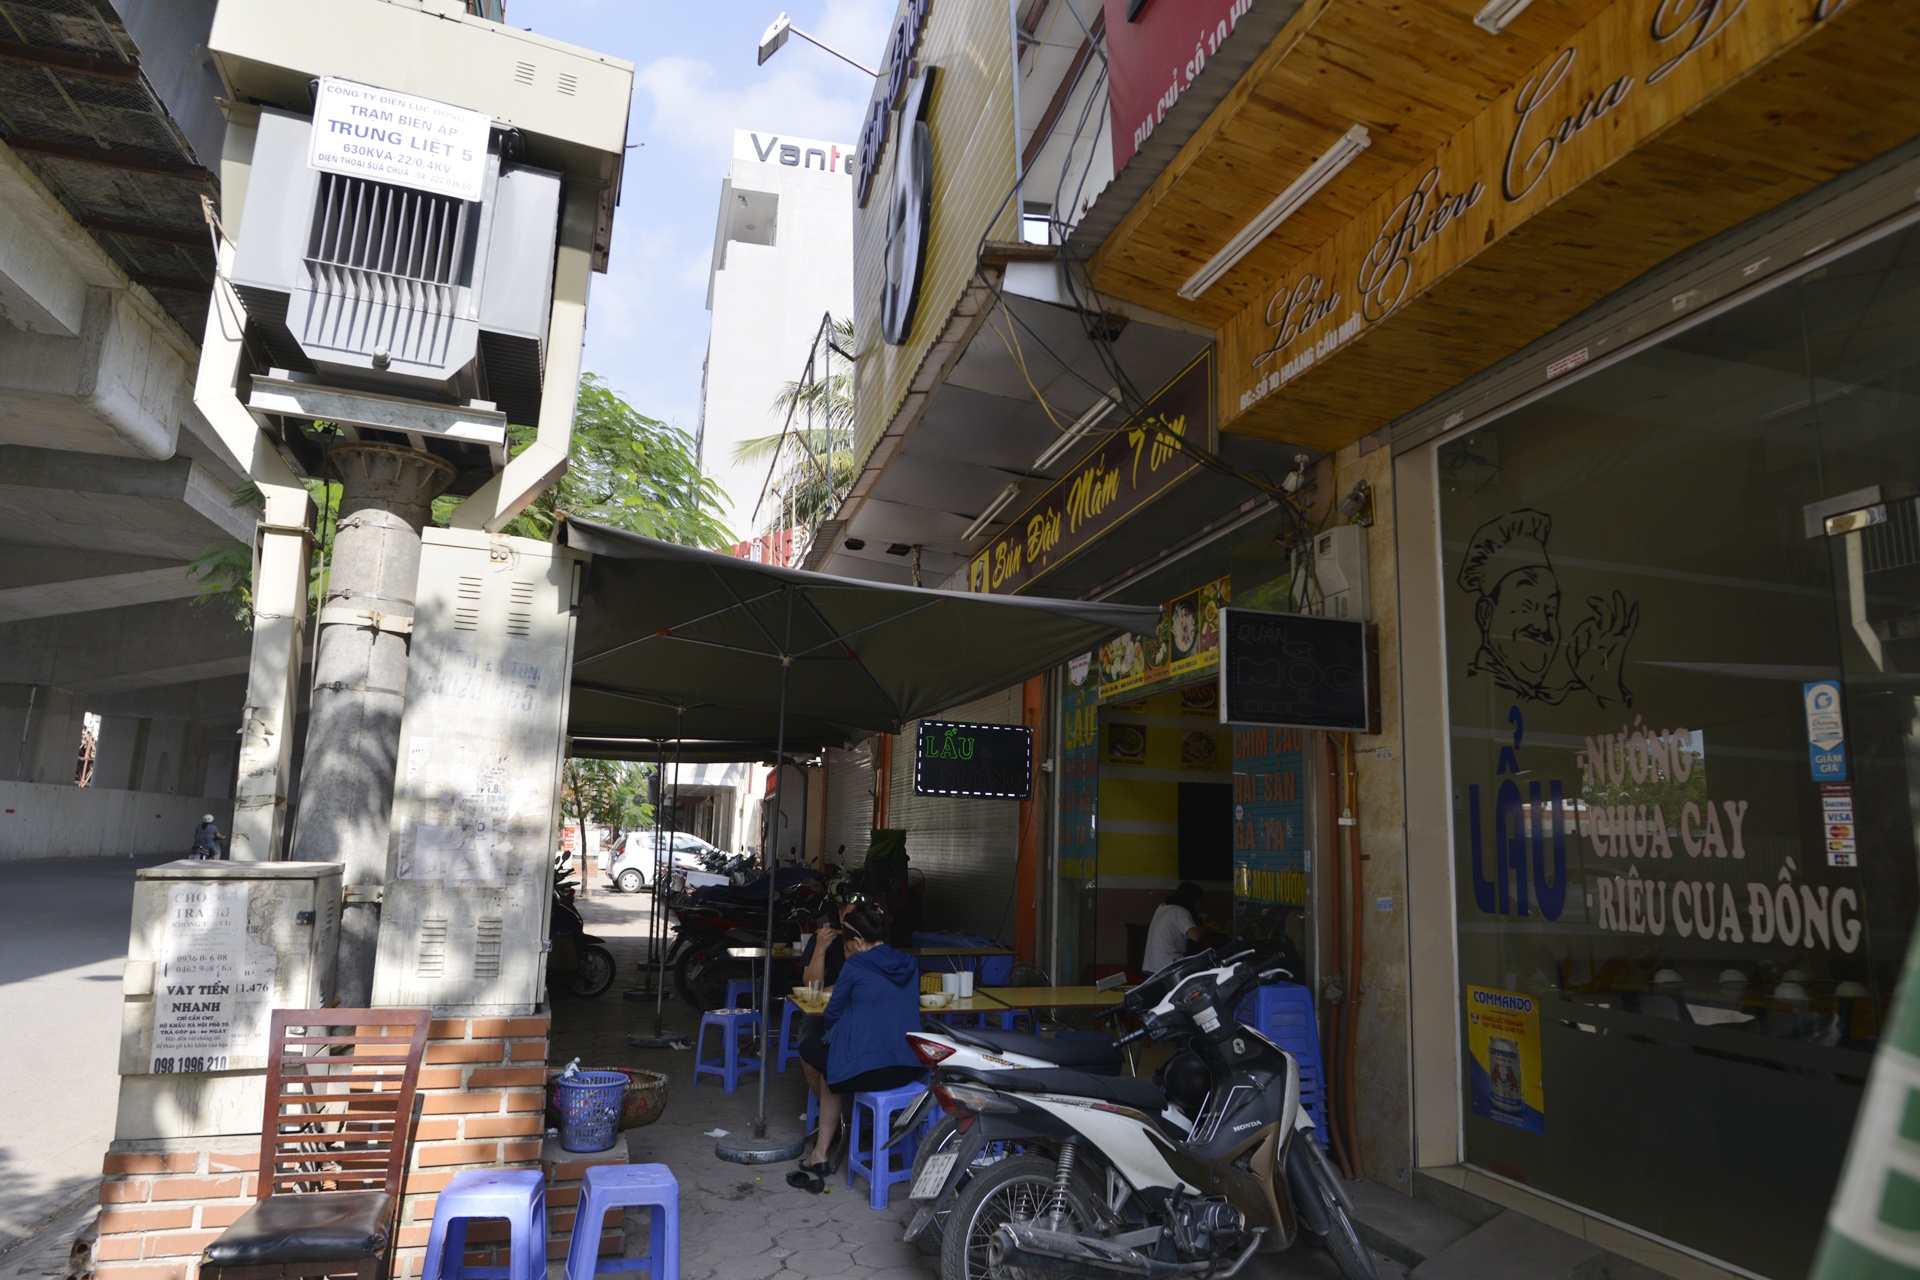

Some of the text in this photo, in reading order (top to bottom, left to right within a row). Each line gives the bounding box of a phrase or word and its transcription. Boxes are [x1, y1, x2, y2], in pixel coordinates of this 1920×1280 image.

[363, 92, 376, 101] TY
[349, 104, 393, 123] TRẠM
[1502, 46, 1635, 202] Cua
[327, 119, 473, 162] TRUNG LIỆT 5
[992, 537, 1022, 589] Bún
[1026, 505, 1063, 567] Đậu
[1066, 452, 1121, 534] Mắm
[925, 727, 975, 760] LẨU
[1234, 727, 1268, 759] CHIM
[1469, 705, 1566, 922] LẨU
[1827, 813, 1851, 821] VISA
[1264, 820, 1285, 850] TA
[1681, 800, 1748, 859] CAY
[1671, 880, 1744, 943] CUA
[1747, 855, 1862, 954] ĐỒNG
[166, 980, 230, 996] VAY TIỀN
[1473, 990, 1533, 1013] COMMANDO
[172, 1002, 221, 1013] NHANH
[154, 1057, 175, 1074] 098
[178, 1056, 205, 1073] 1996
[1233, 1120, 1262, 1132] HONDA
